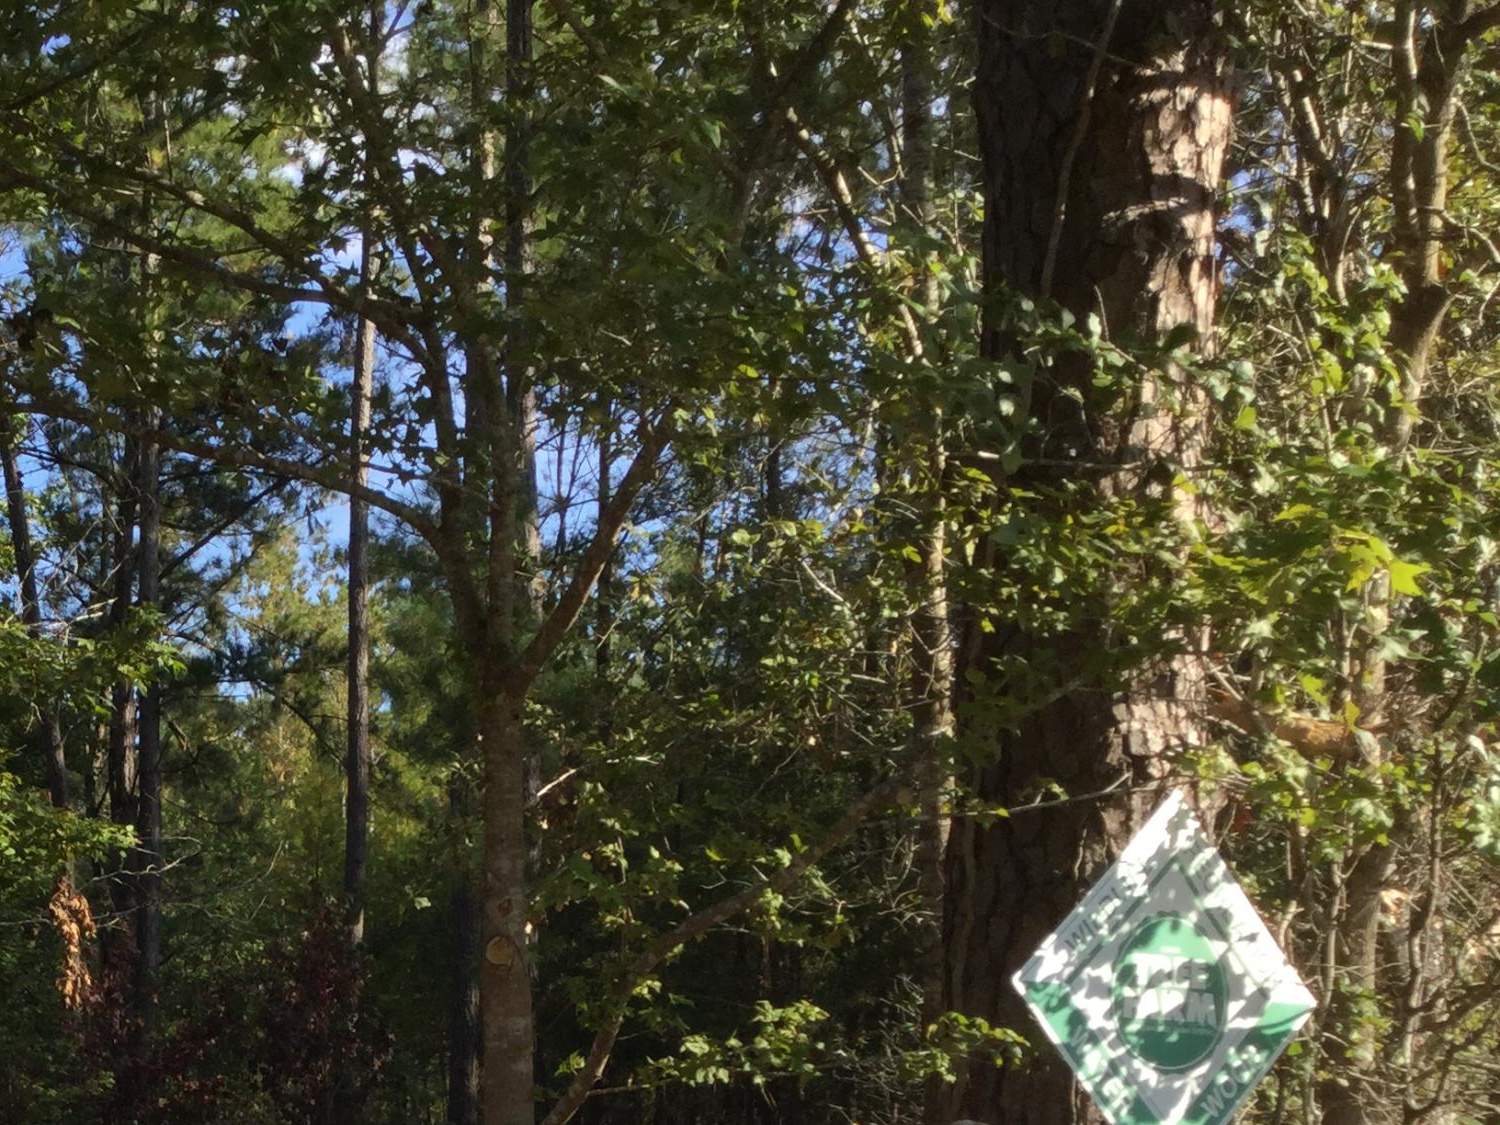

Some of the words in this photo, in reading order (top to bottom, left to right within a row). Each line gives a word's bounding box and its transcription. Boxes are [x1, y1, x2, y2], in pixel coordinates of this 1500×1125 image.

[1132, 953, 1209, 991] TREE
[1122, 987, 1218, 1026] FARM
[1068, 1024, 1137, 1117] WER
